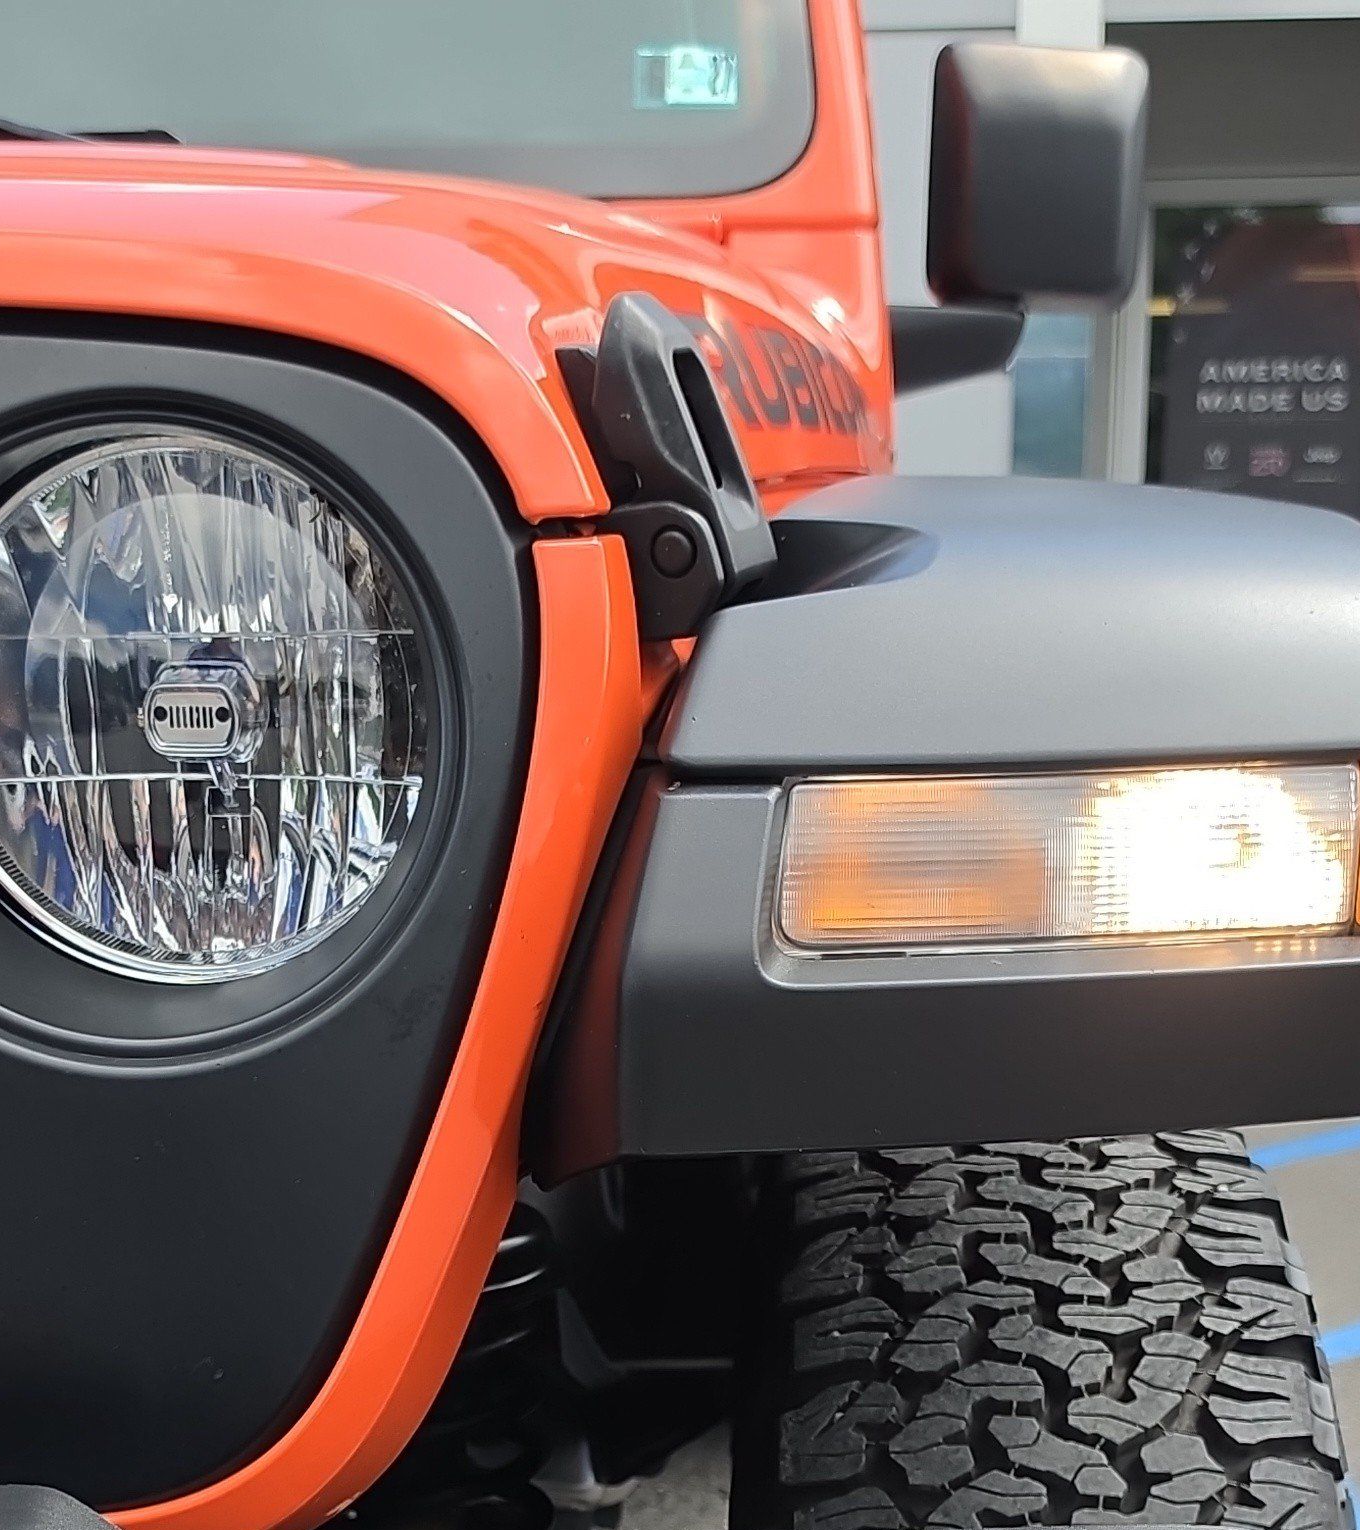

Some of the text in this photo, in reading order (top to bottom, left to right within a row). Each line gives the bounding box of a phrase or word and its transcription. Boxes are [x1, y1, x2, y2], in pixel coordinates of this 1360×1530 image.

[1199, 357, 1348, 383] AMERICA
[1196, 385, 1349, 413] MADE US
